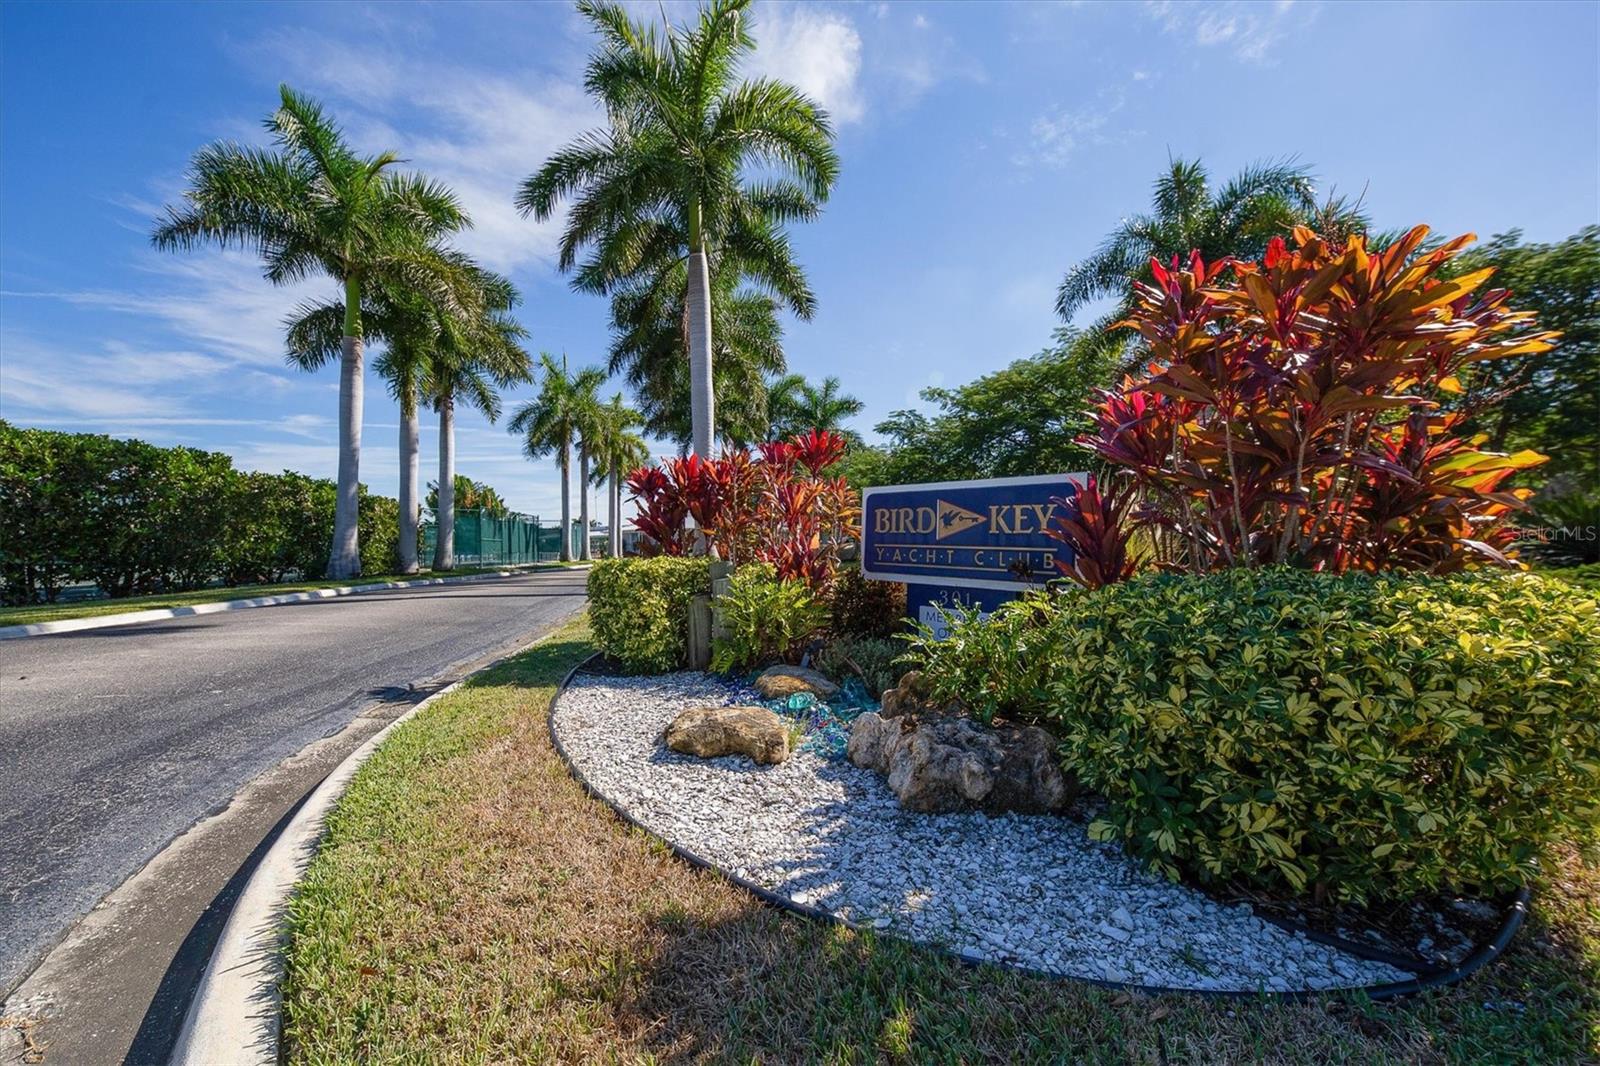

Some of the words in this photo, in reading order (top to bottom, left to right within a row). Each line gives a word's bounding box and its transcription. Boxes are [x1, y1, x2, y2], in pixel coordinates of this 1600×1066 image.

[875, 507, 936, 534] BIRD
[988, 503, 1057, 534] KEY
[939, 590, 971, 608] 301
